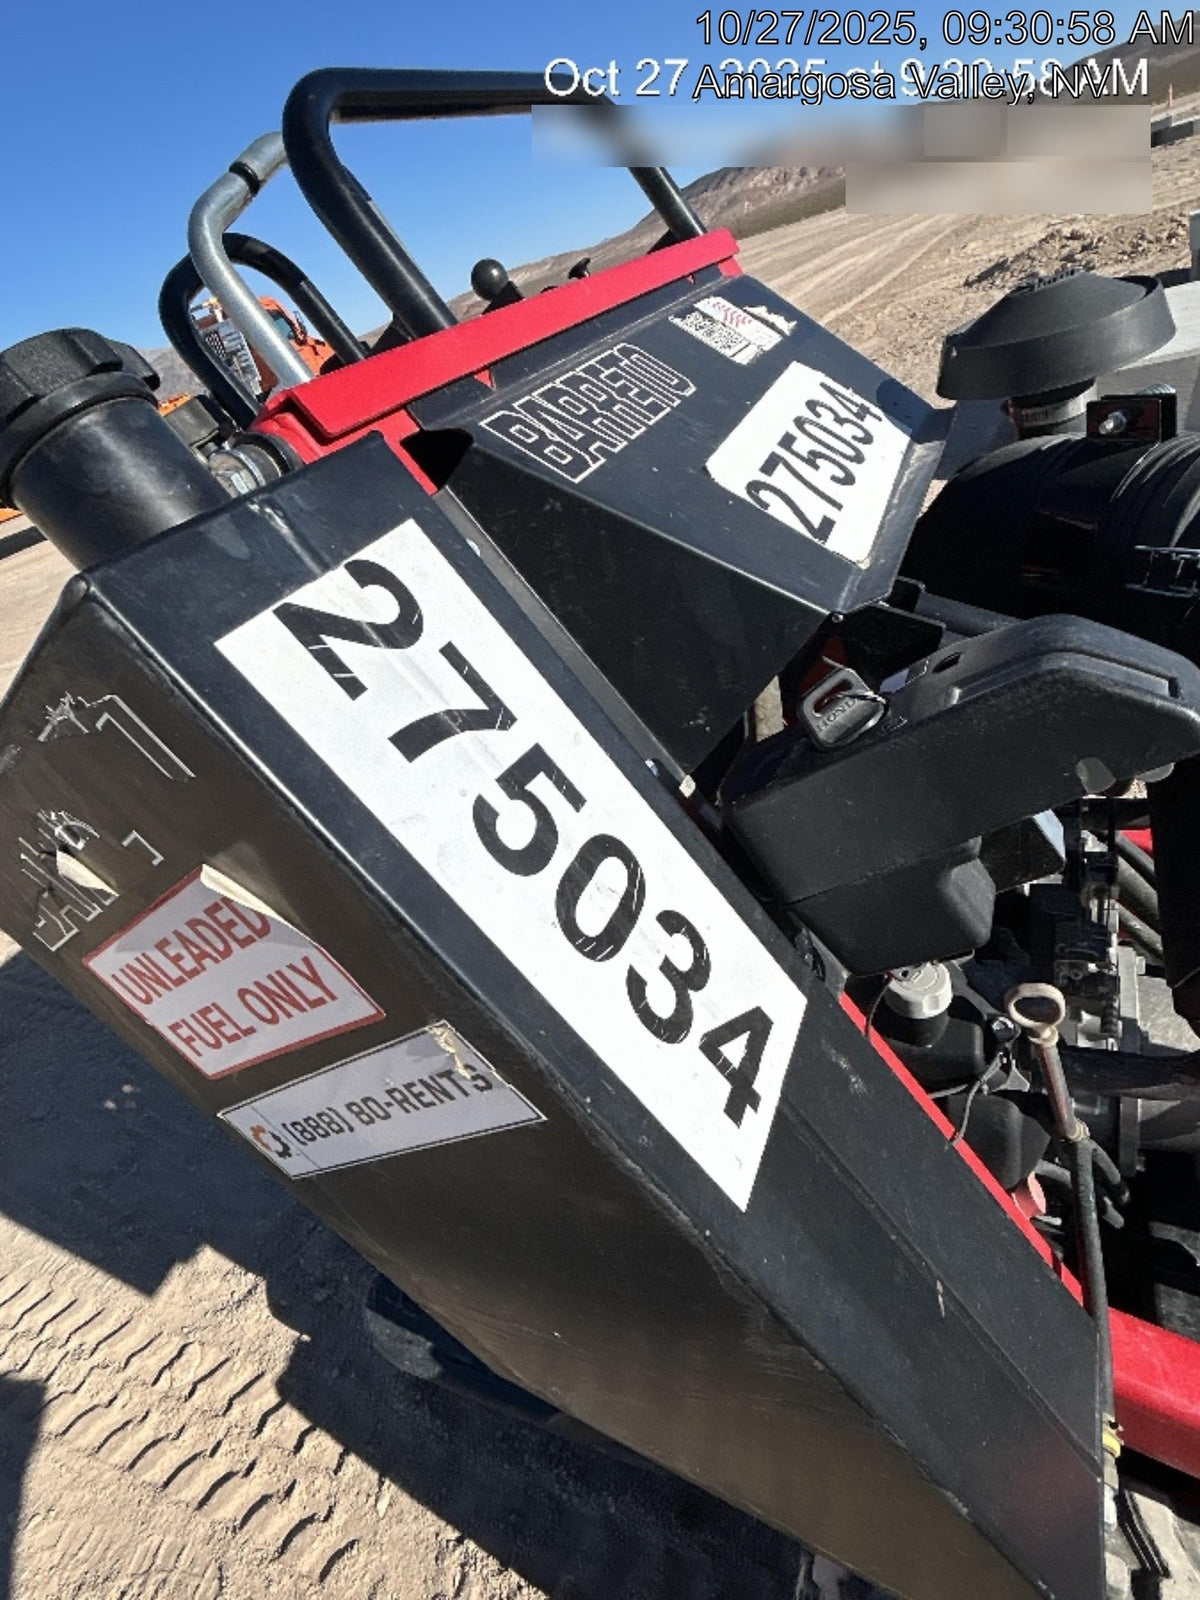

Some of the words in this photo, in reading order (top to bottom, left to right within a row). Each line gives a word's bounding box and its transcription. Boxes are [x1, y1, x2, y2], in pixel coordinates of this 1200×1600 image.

[479, 343, 697, 483] BARRETO
[745, 381, 882, 544] 275034
[816, 697, 857, 732] HOND
[272, 558, 774, 1129] 275034
[111, 896, 271, 1005] UNLEADED
[167, 1002, 257, 1057] FUEL
[237, 955, 338, 1026] ONLY
[281, 1107, 354, 1146] (888)
[346, 1064, 494, 1126] 80-RENTS
